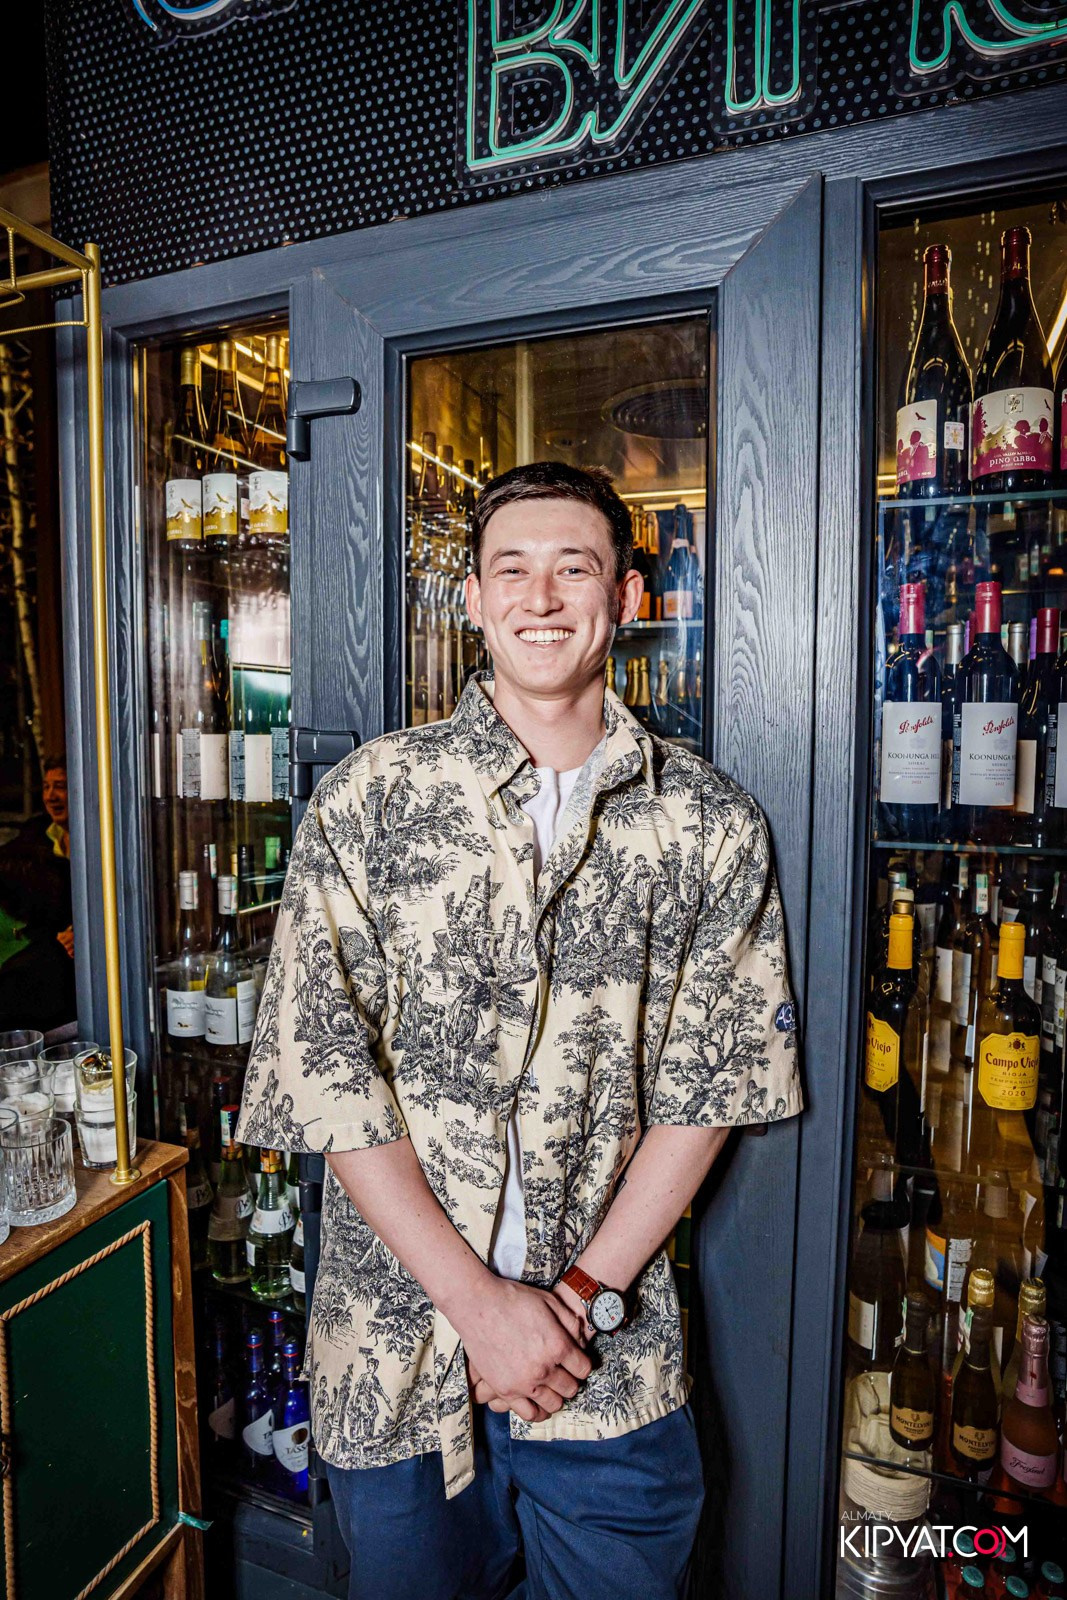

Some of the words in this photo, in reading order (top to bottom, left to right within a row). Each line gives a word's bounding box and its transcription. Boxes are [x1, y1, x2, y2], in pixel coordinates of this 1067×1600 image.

[887, 752, 929, 760] KOONUNGA
[871, 1037, 891, 1055] Viejo
[985, 1052, 1019, 1071] Campo
[286, 1444, 307, 1455] TASS
